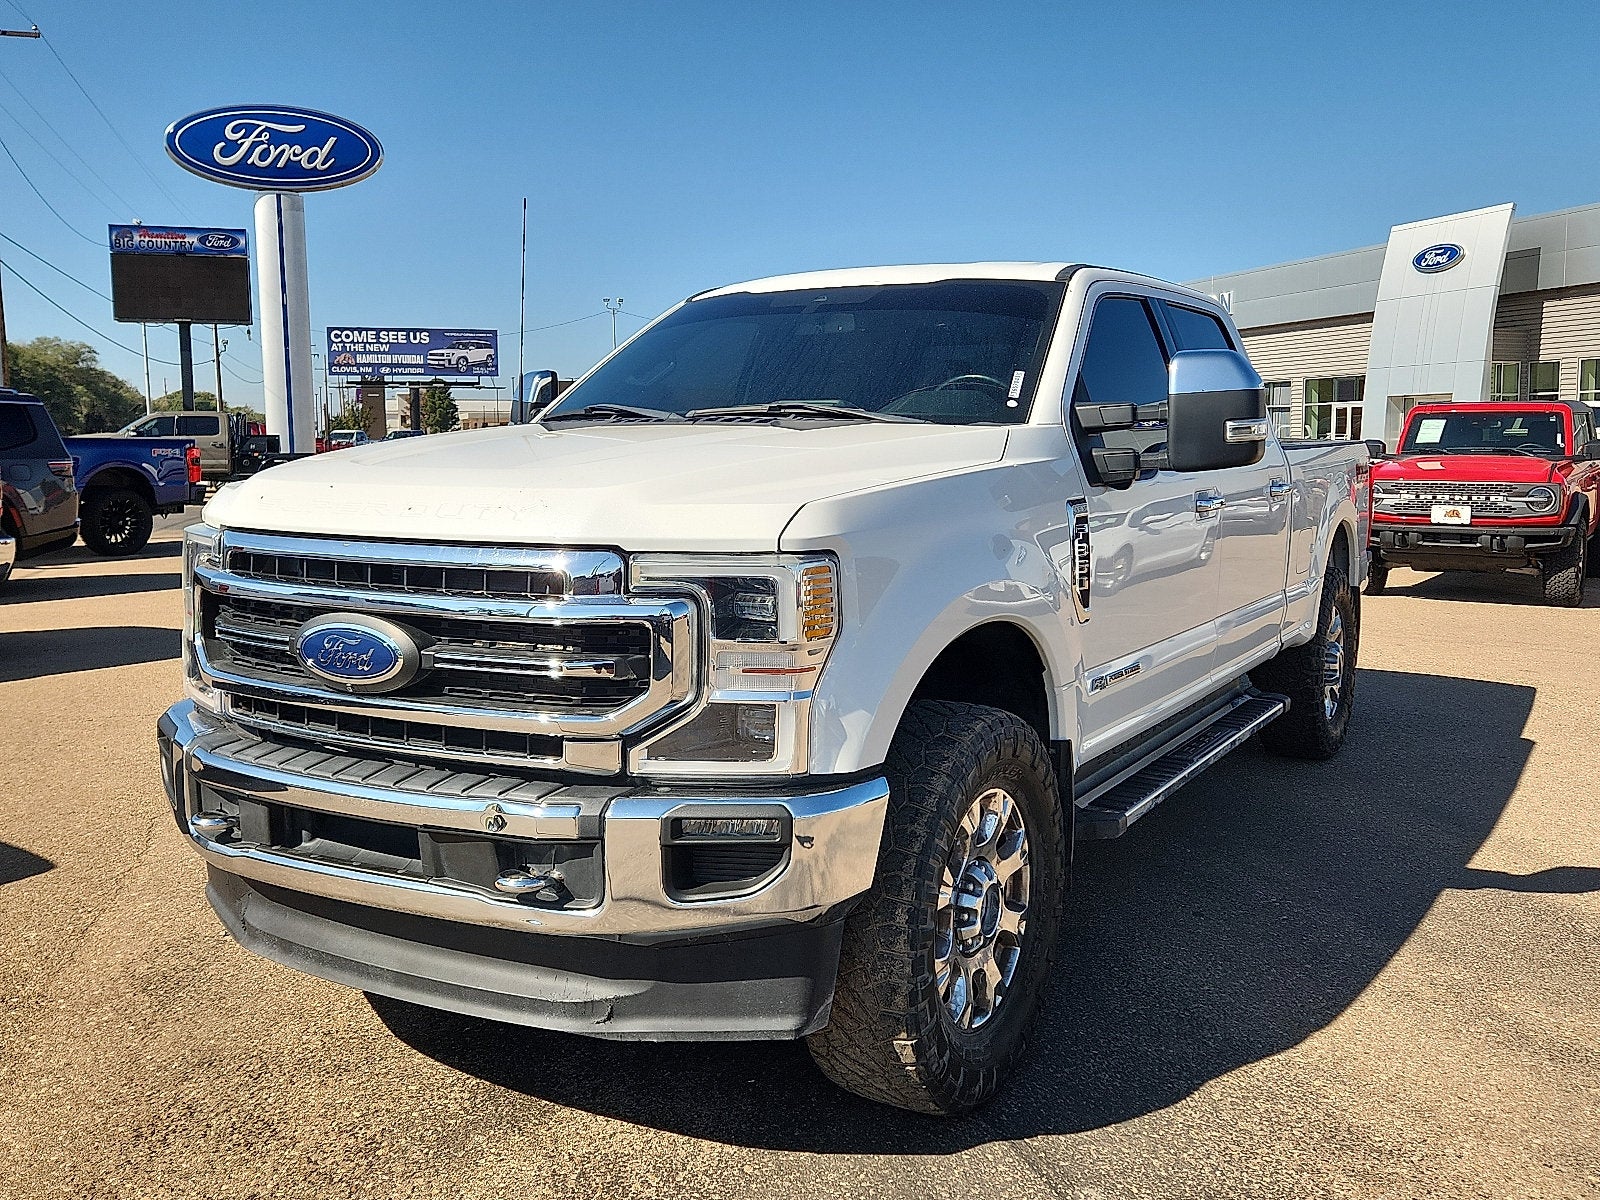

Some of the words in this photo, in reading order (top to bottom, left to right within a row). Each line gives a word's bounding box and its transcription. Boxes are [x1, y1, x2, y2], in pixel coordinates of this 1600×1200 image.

[213, 119, 338, 170] Ford
[114, 239, 134, 249] BIG
[138, 240, 195, 251] COUNTRY
[205, 234, 232, 248] Ford
[1421, 249, 1451, 266] Ford
[330, 330, 377, 343] COME
[379, 331, 407, 343] SEE
[409, 331, 430, 344] US
[330, 343, 344, 351] AT
[345, 343, 365, 352] THE
[366, 344, 390, 352] NEW
[356, 354, 392, 364] HAMILTON
[392, 354, 424, 364] HYUNDAI
[318, 634, 375, 672] Ford
